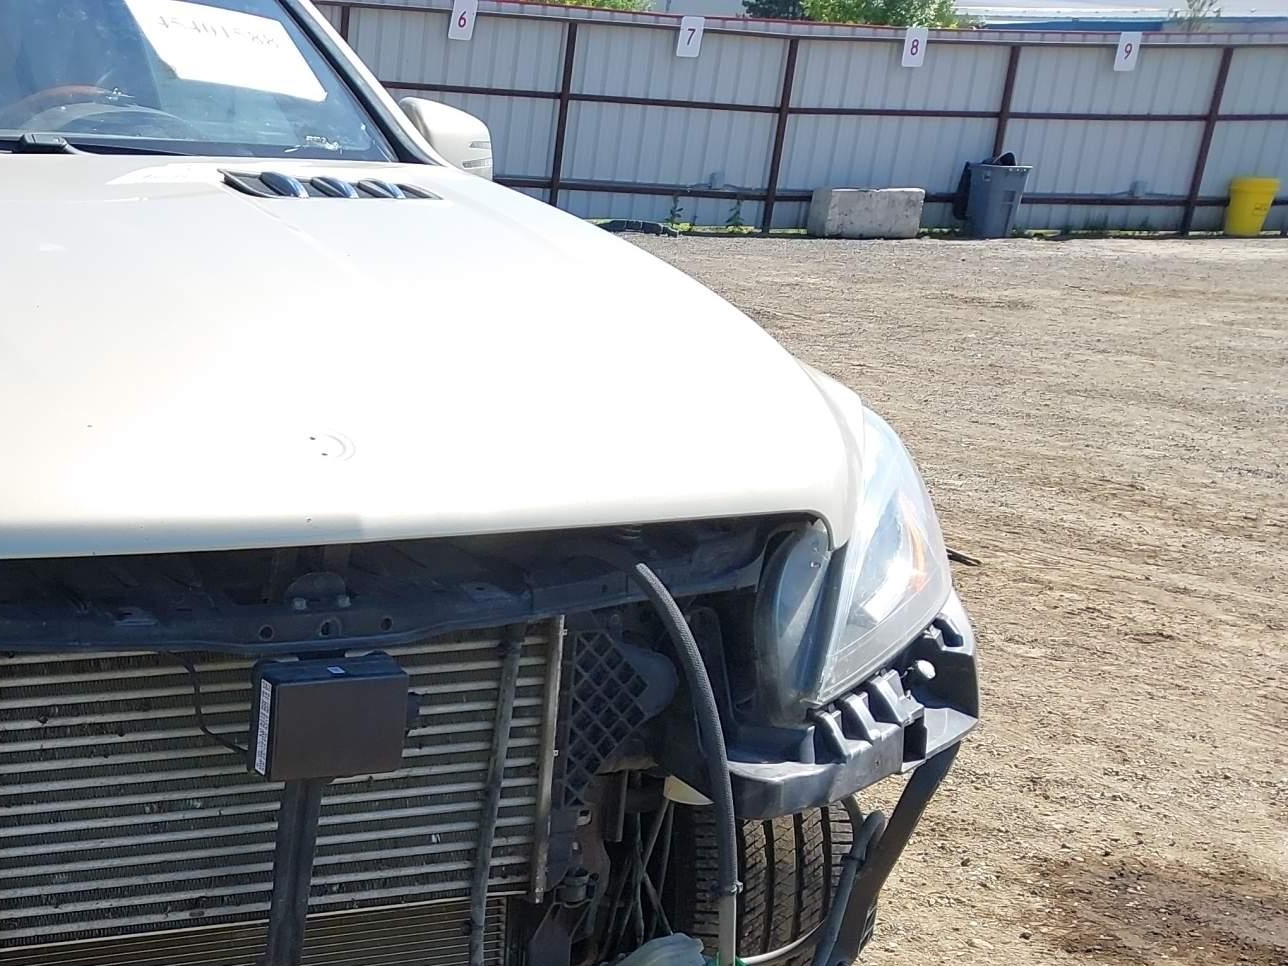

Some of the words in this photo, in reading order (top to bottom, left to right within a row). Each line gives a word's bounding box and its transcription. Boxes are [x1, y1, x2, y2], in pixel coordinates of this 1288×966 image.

[458, 11, 467, 28] 6
[687, 28, 696, 46] 7
[910, 38, 919, 56] 8
[1124, 42, 1133, 60] 9
